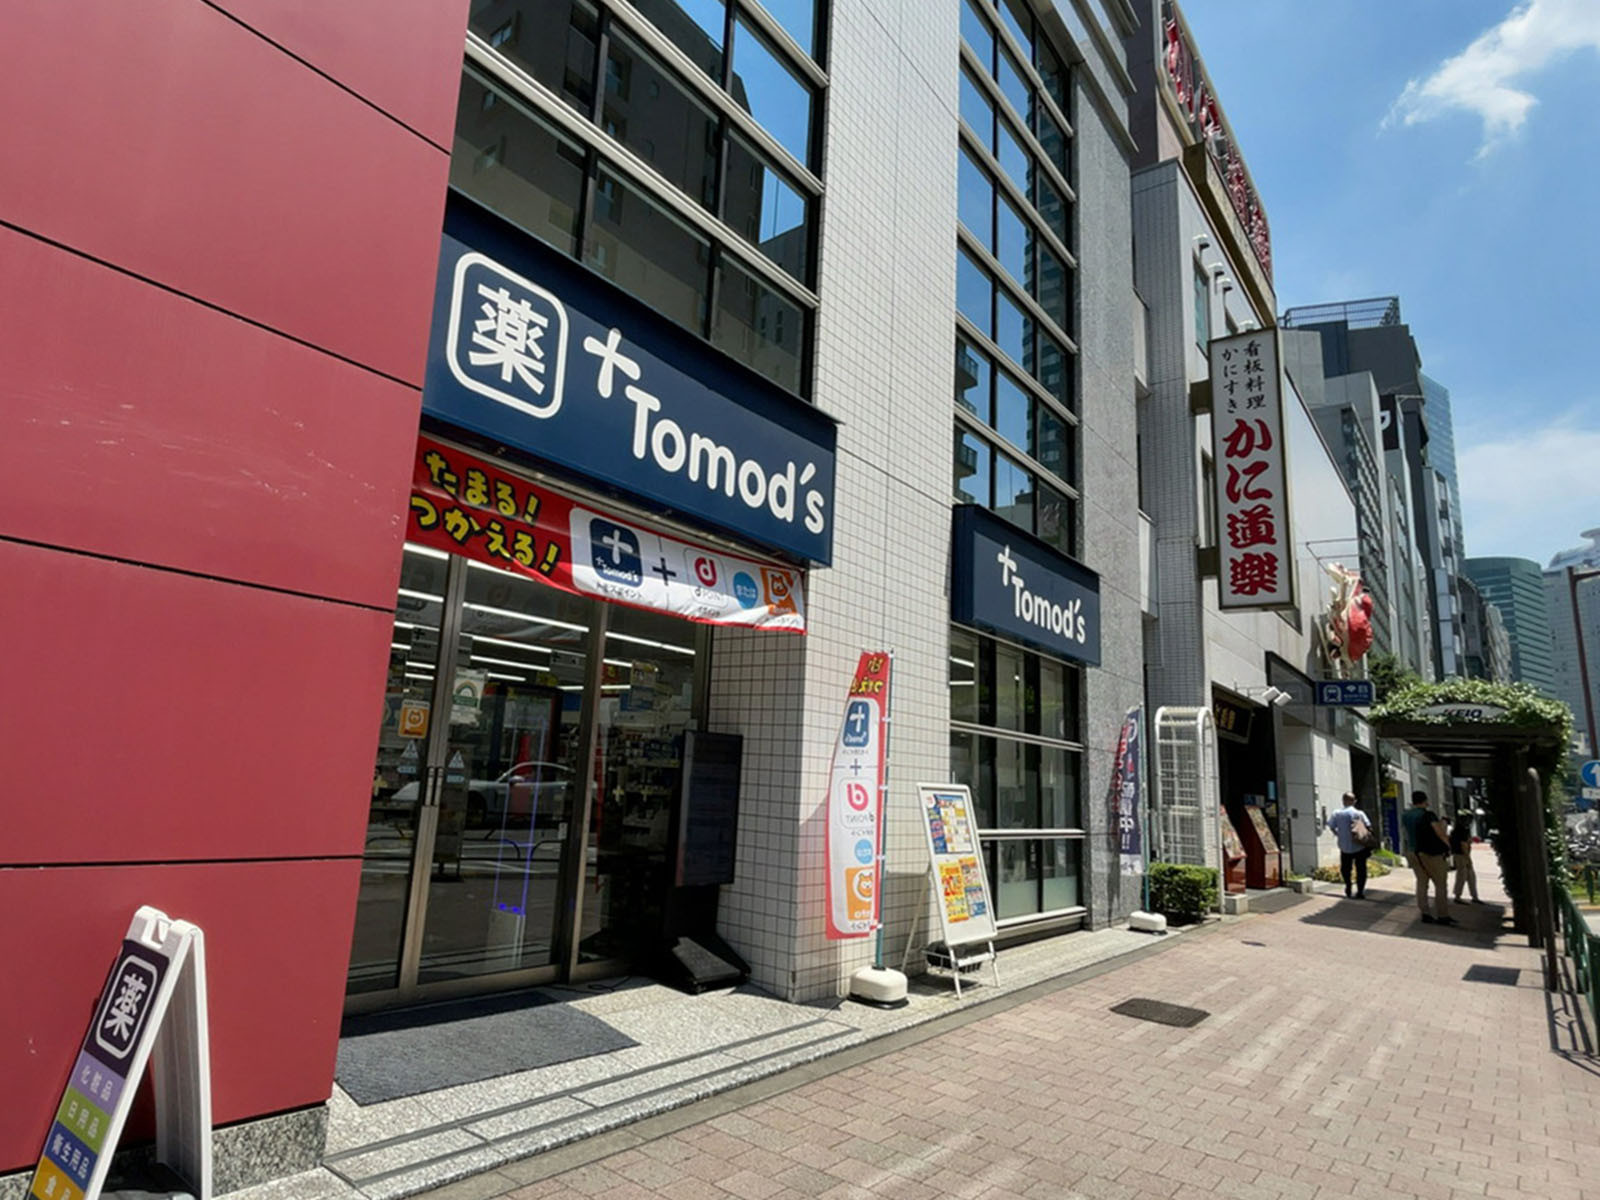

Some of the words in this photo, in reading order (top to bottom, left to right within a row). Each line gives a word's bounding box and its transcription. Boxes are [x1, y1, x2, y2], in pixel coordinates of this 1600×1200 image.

[468, 282, 549, 396] 薬
[1221, 347, 1240, 414] かにすき
[1243, 339, 1267, 411] 看板料理
[625, 384, 825, 534] Tomod's
[1011, 575, 1086, 645] Tomod's
[1444, 707, 1483, 717] KEIO
[104, 973, 148, 1042] 薬
